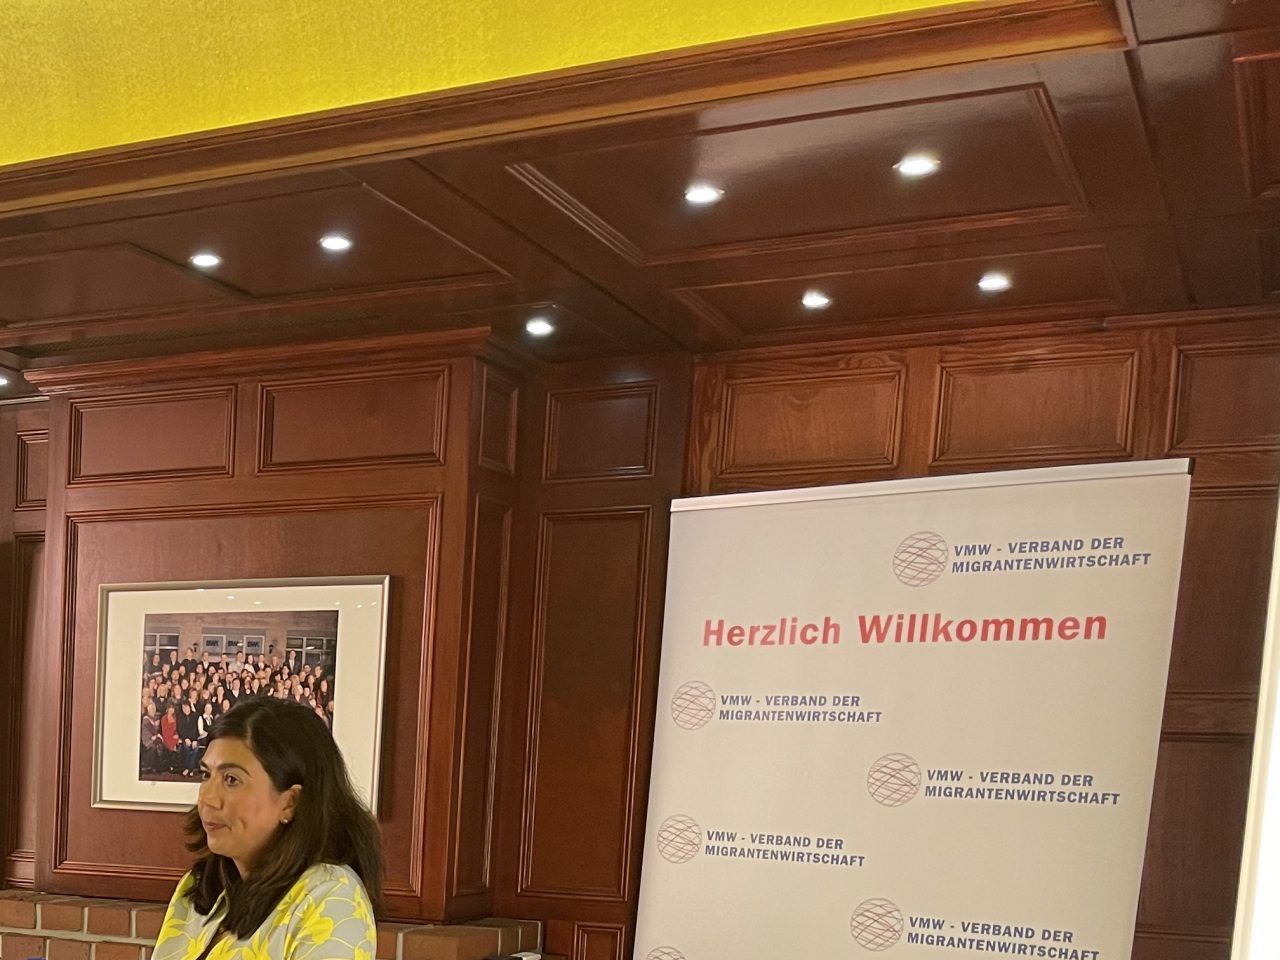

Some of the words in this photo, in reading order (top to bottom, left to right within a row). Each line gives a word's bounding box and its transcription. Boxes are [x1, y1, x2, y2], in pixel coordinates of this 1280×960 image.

[954, 543, 992, 557] VMW
[1008, 539, 1084, 554] VERBAND
[1090, 537, 1125, 550] DER
[952, 553, 1152, 573] MIGRANTENWIRTSCHAFT
[703, 616, 840, 646] Herzlich
[858, 613, 1107, 644] Willkommen
[720, 695, 752, 706] VMW
[765, 695, 827, 706] VERBAND
[832, 695, 860, 707] DER
[719, 709, 882, 723] MIGRANTENWIRTSCHAFT
[927, 769, 964, 782] VMW
[980, 771, 1055, 785] VERBAND
[1061, 774, 1094, 787] DER
[925, 785, 1121, 805] MIGRANTENWIRTSCHAFT
[707, 830, 737, 842] VMW
[750, 833, 811, 847] VERBAND
[816, 837, 844, 850] DER
[705, 845, 865, 867] MIGRANTENWIRTSCHAFT
[909, 916, 945, 930] VMW
[961, 921, 1035, 939] VERBAND
[1041, 929, 1073, 943] DER
